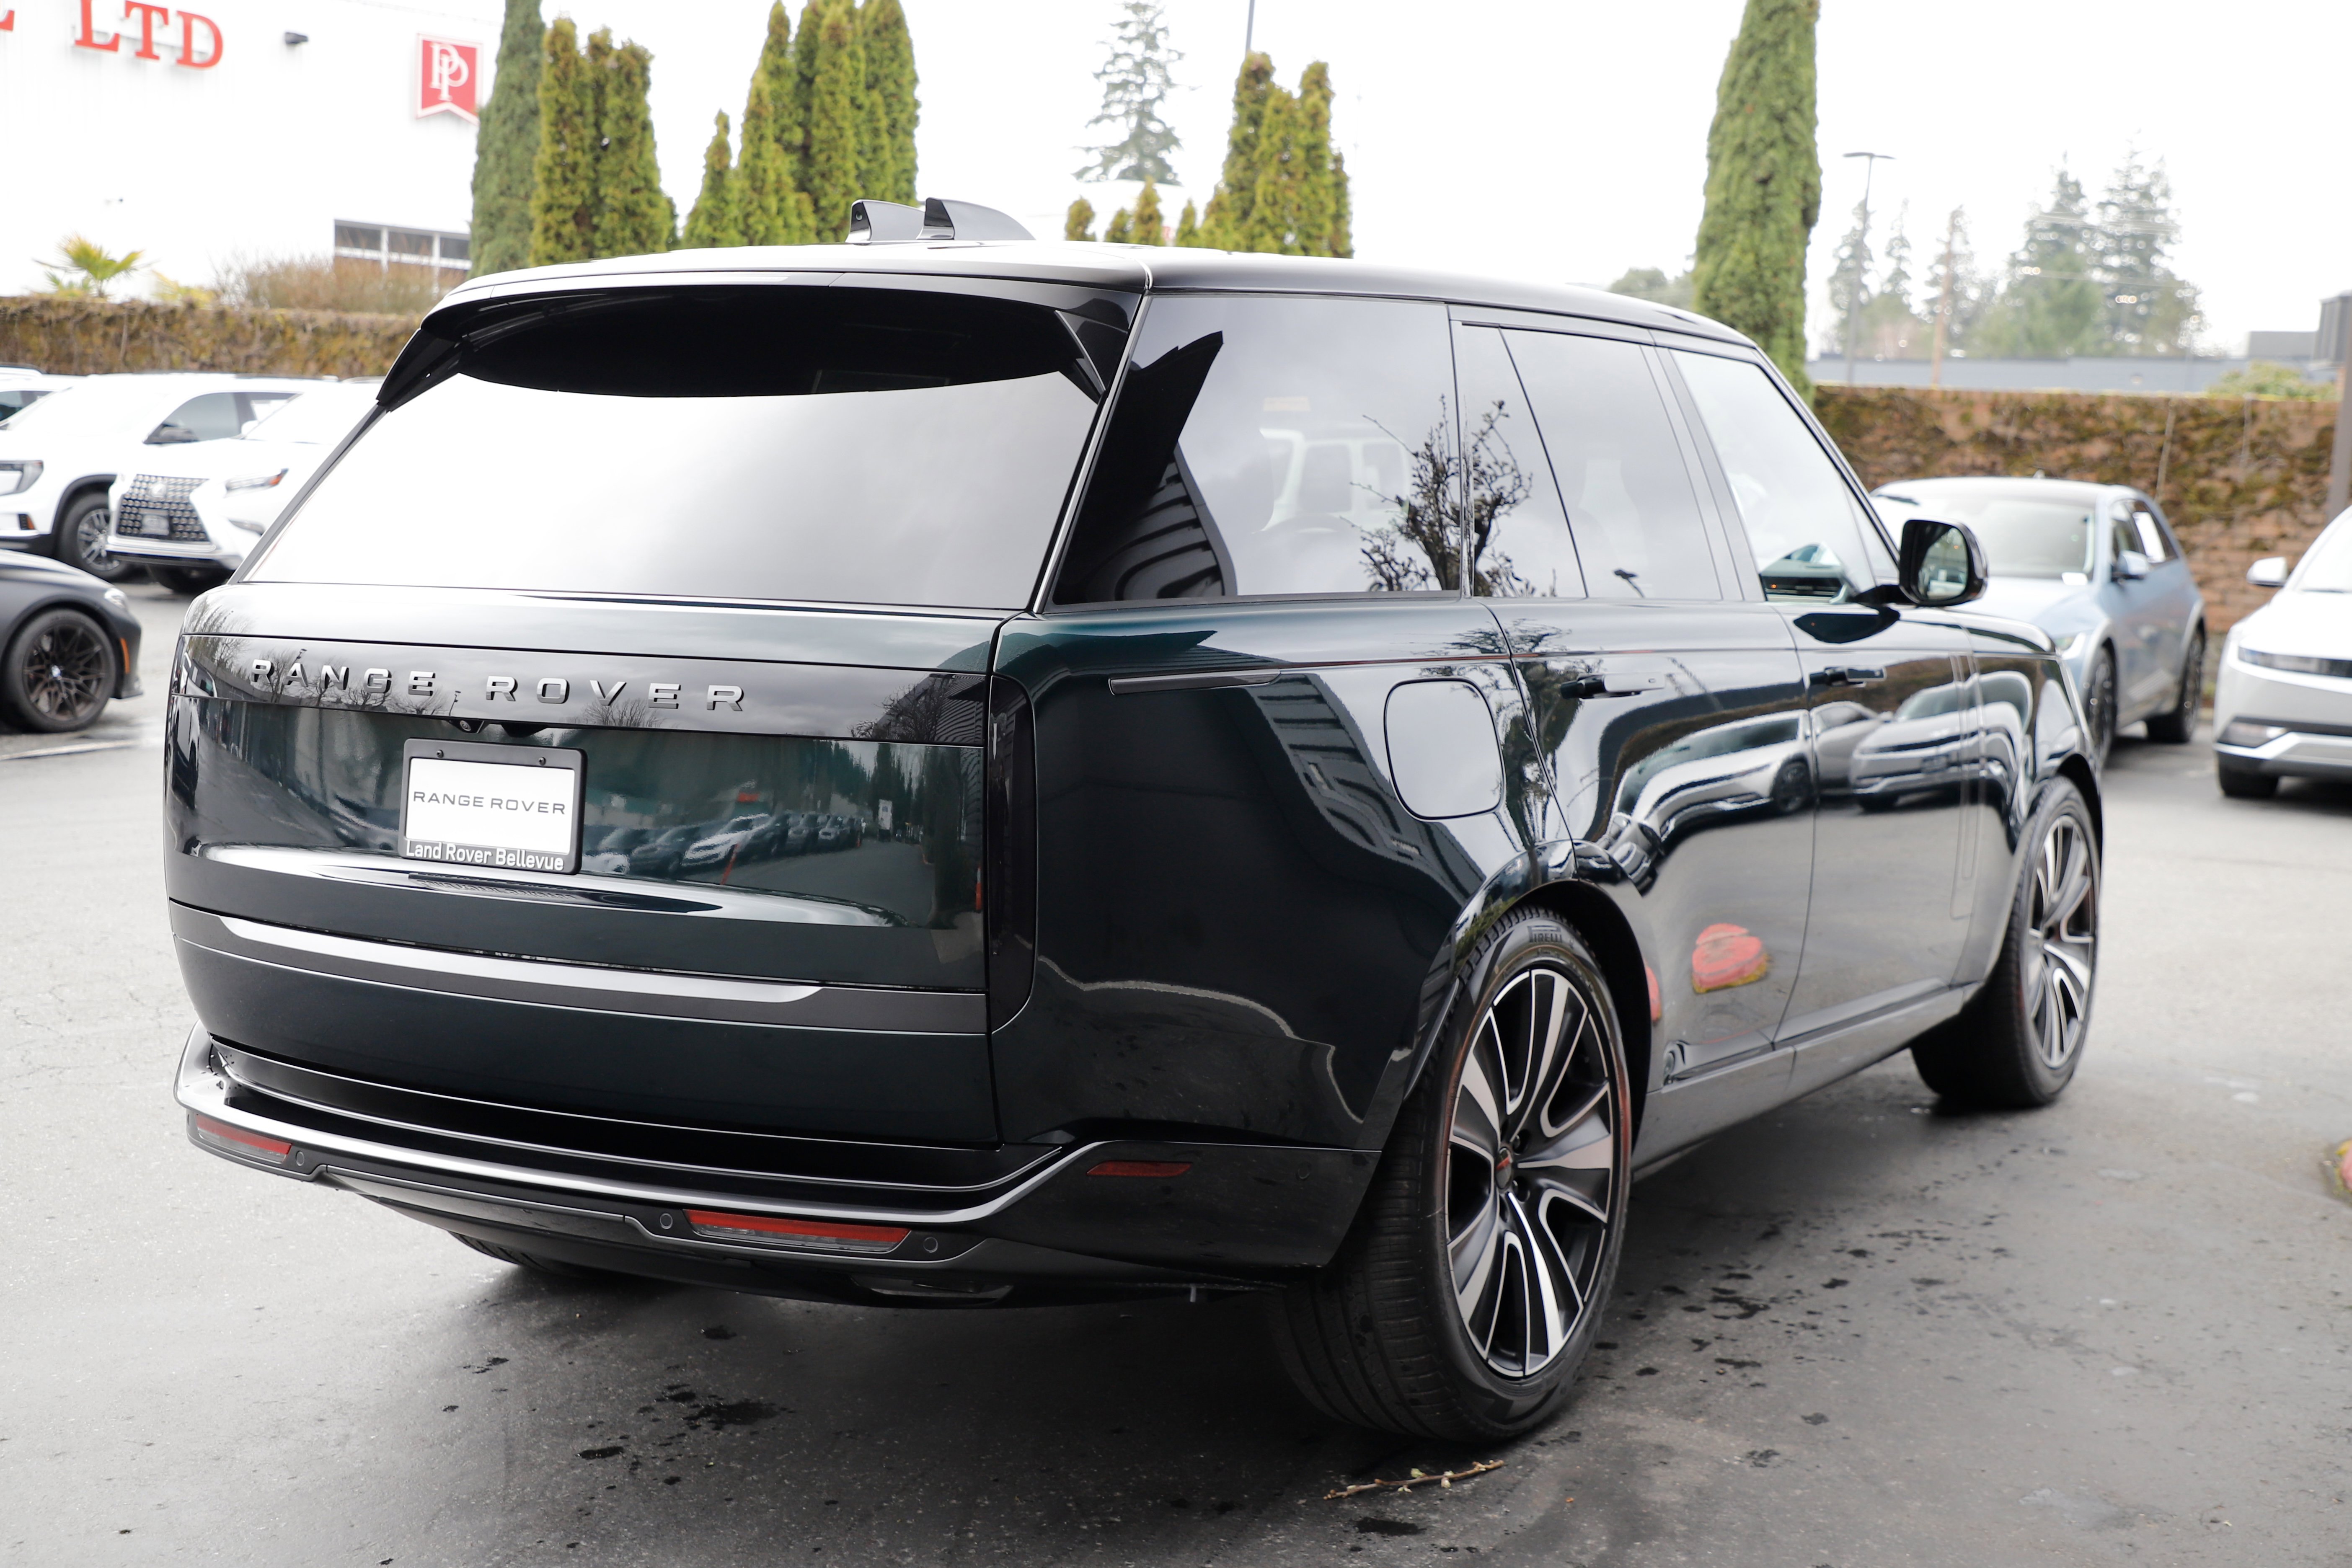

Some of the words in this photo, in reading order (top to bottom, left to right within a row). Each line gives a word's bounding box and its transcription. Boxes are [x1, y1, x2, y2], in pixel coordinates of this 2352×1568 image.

[74, 0, 223, 68] LTD
[252, 659, 435, 696] RANGE
[486, 676, 744, 711] ROVER
[414, 791, 484, 807] RANGE
[490, 798, 566, 814] ROVER
[406, 840, 442, 860] Land
[446, 843, 492, 864] Rover
[495, 848, 564, 871] Bellevue
[1528, 925, 1563, 943] PIRELLI
